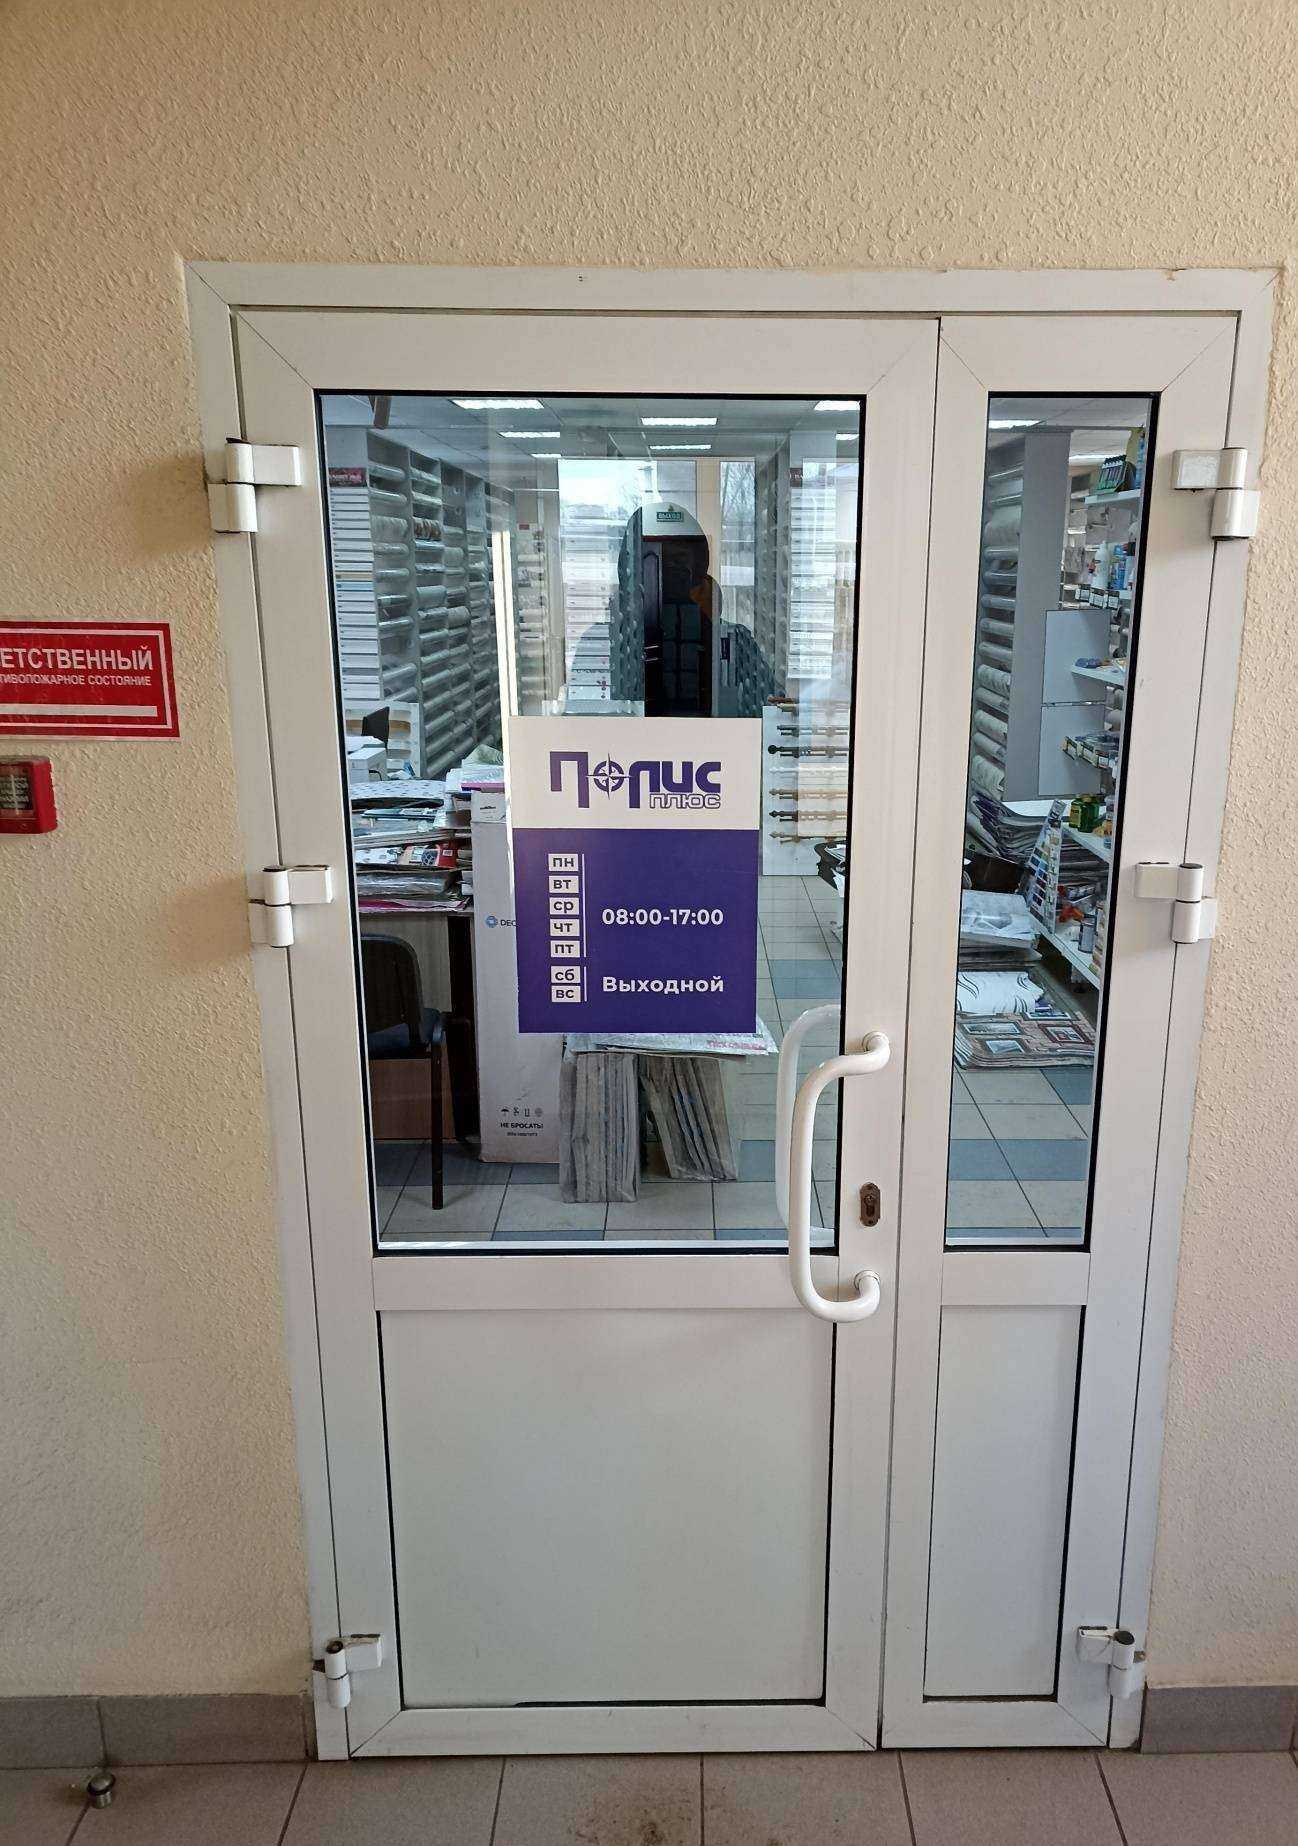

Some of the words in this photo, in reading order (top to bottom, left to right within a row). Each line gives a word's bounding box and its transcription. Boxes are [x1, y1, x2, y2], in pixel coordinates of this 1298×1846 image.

[88, 675, 152, 686] СОСТОЯНИЕ
[602, 908, 724, 926] 08:00-17:00
[555, 968, 575, 981] сб
[602, 975, 724, 995] Выходной
